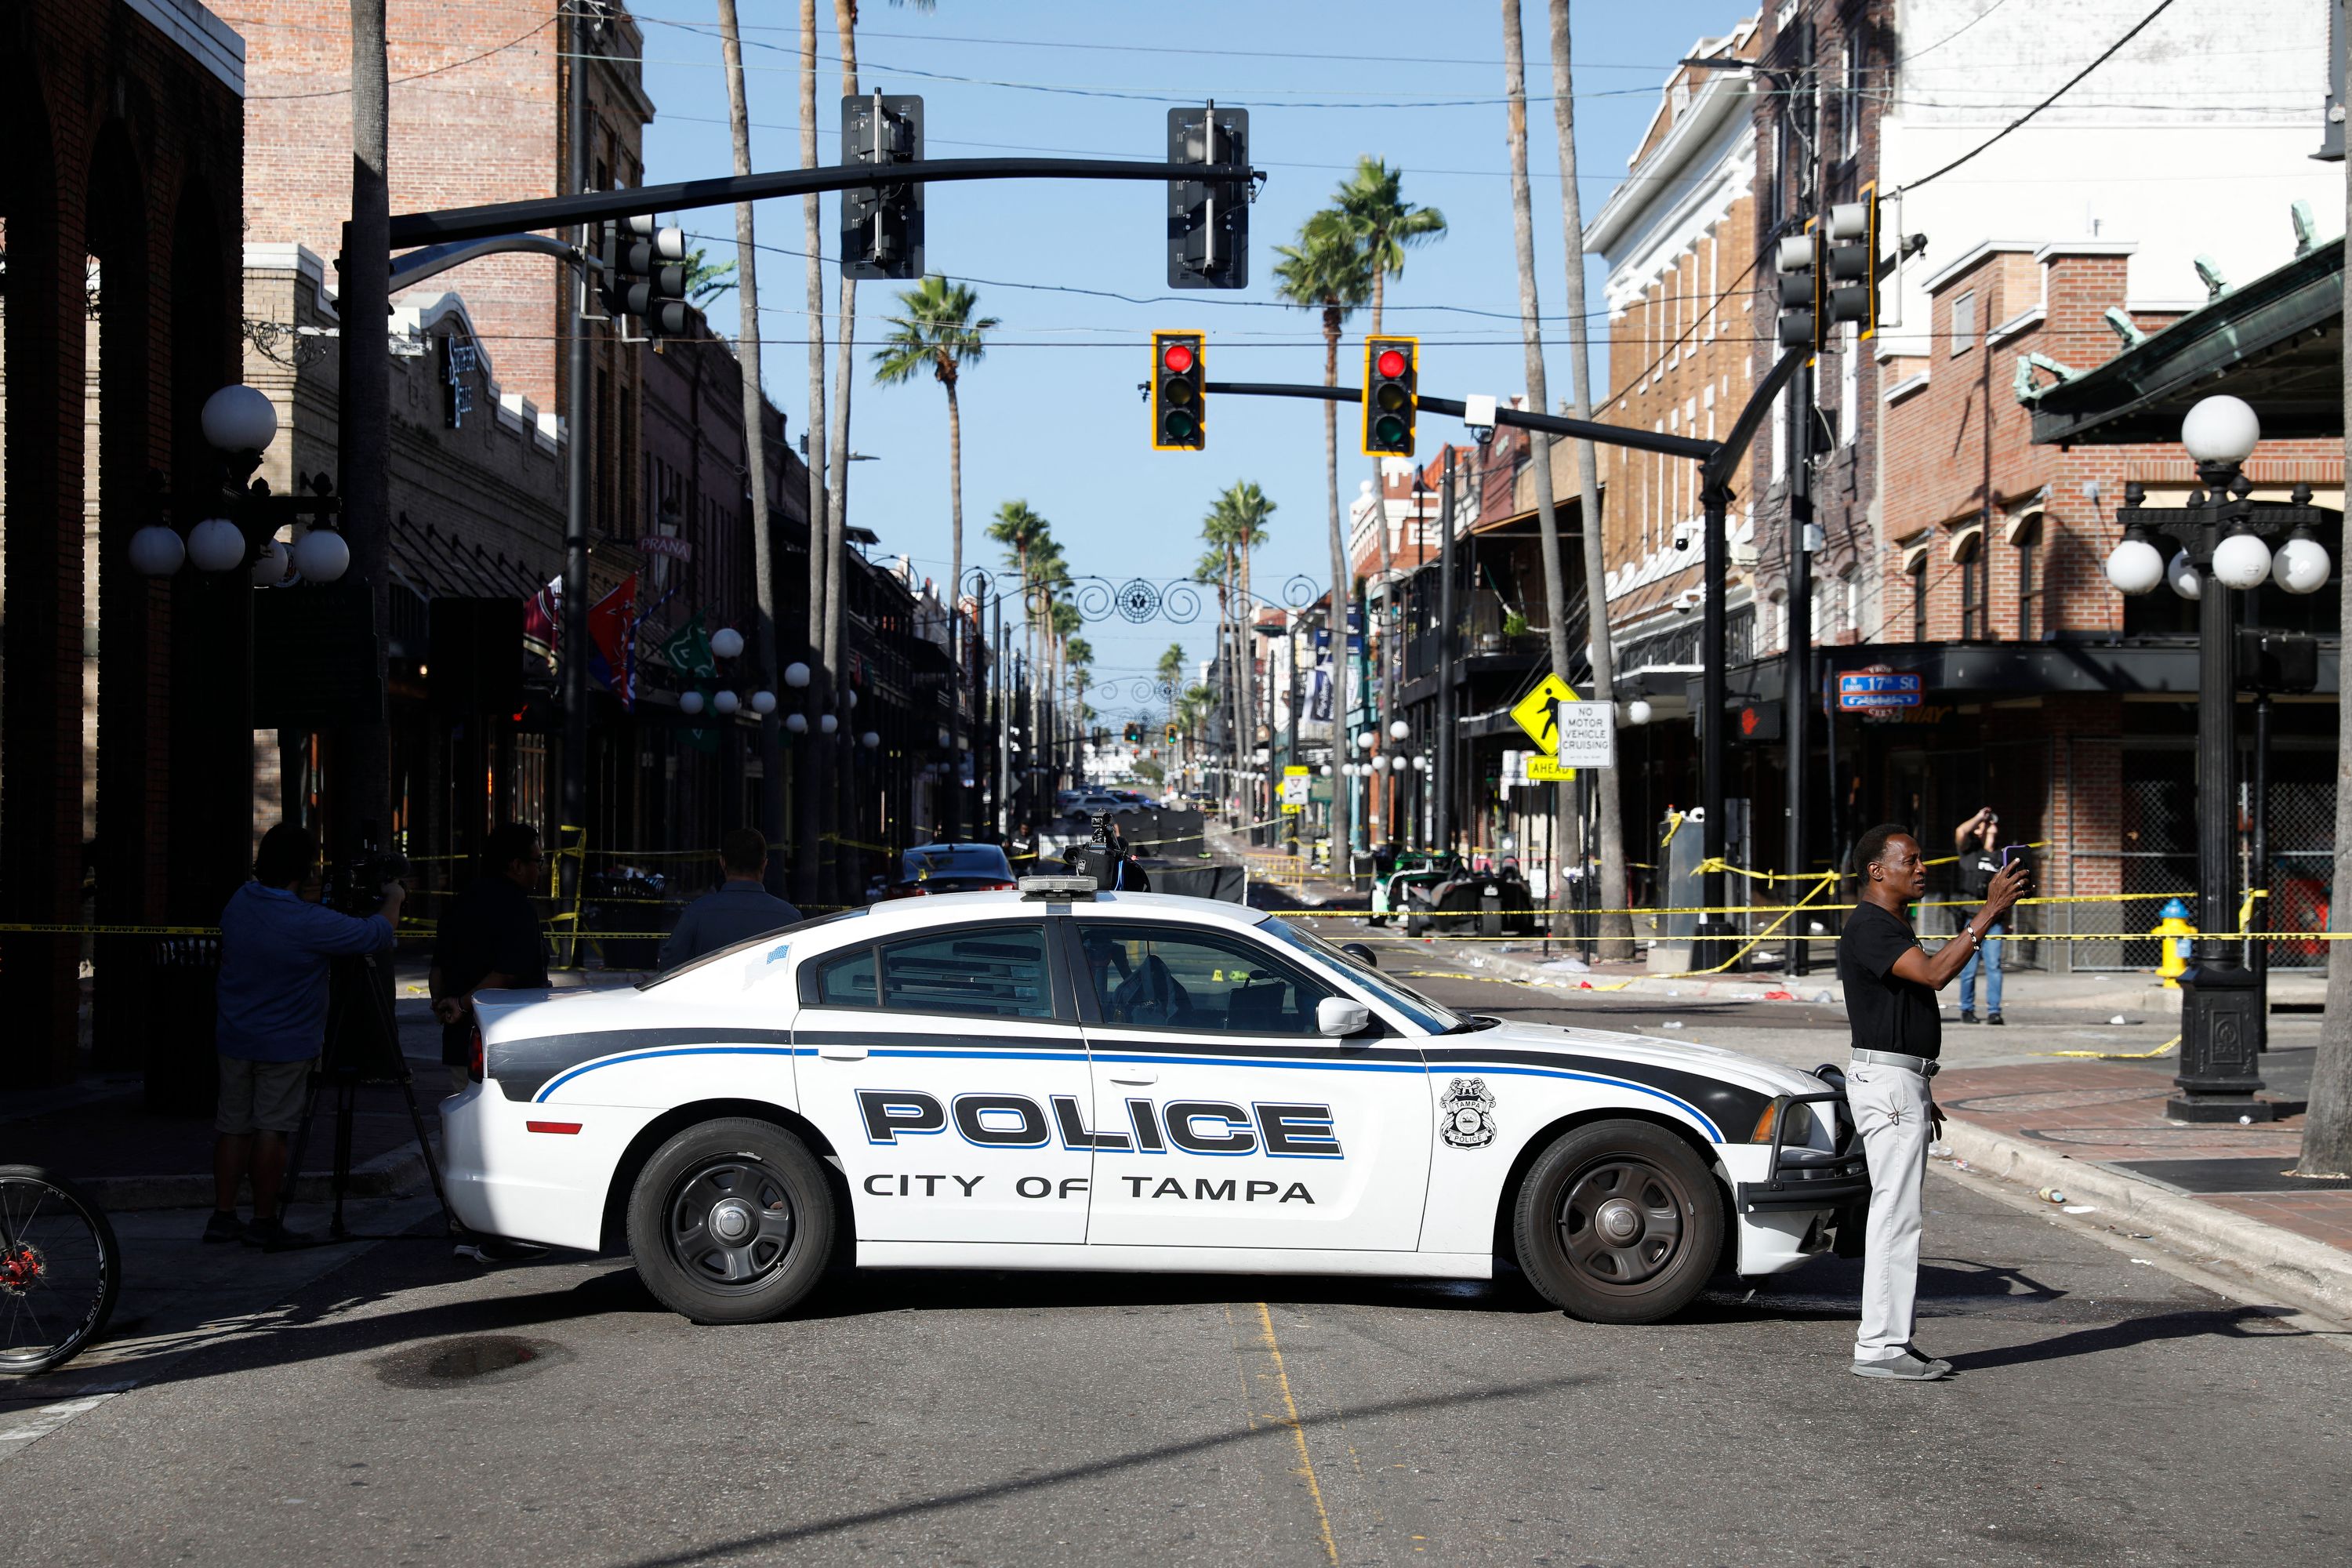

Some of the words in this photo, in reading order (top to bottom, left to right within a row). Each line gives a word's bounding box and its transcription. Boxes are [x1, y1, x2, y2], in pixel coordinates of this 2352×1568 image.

[641, 537, 688, 558] PRANA
[1868, 677, 1893, 691] 17th
[1900, 677, 1915, 690] St
[1578, 708, 1593, 717] NO
[1568, 719, 1603, 728] MOTOR
[1565, 730, 1606, 739] VEHICLE
[1563, 741, 1608, 750] CRUISING
[1533, 763, 1569, 775] AHEAD
[854, 1088, 1345, 1160] POLICE
[1454, 1134, 1483, 1143] POLICE
[864, 1174, 985, 1197] CITY
[1015, 1176, 1089, 1200] OF
[1121, 1176, 1316, 1204] TAMPA
